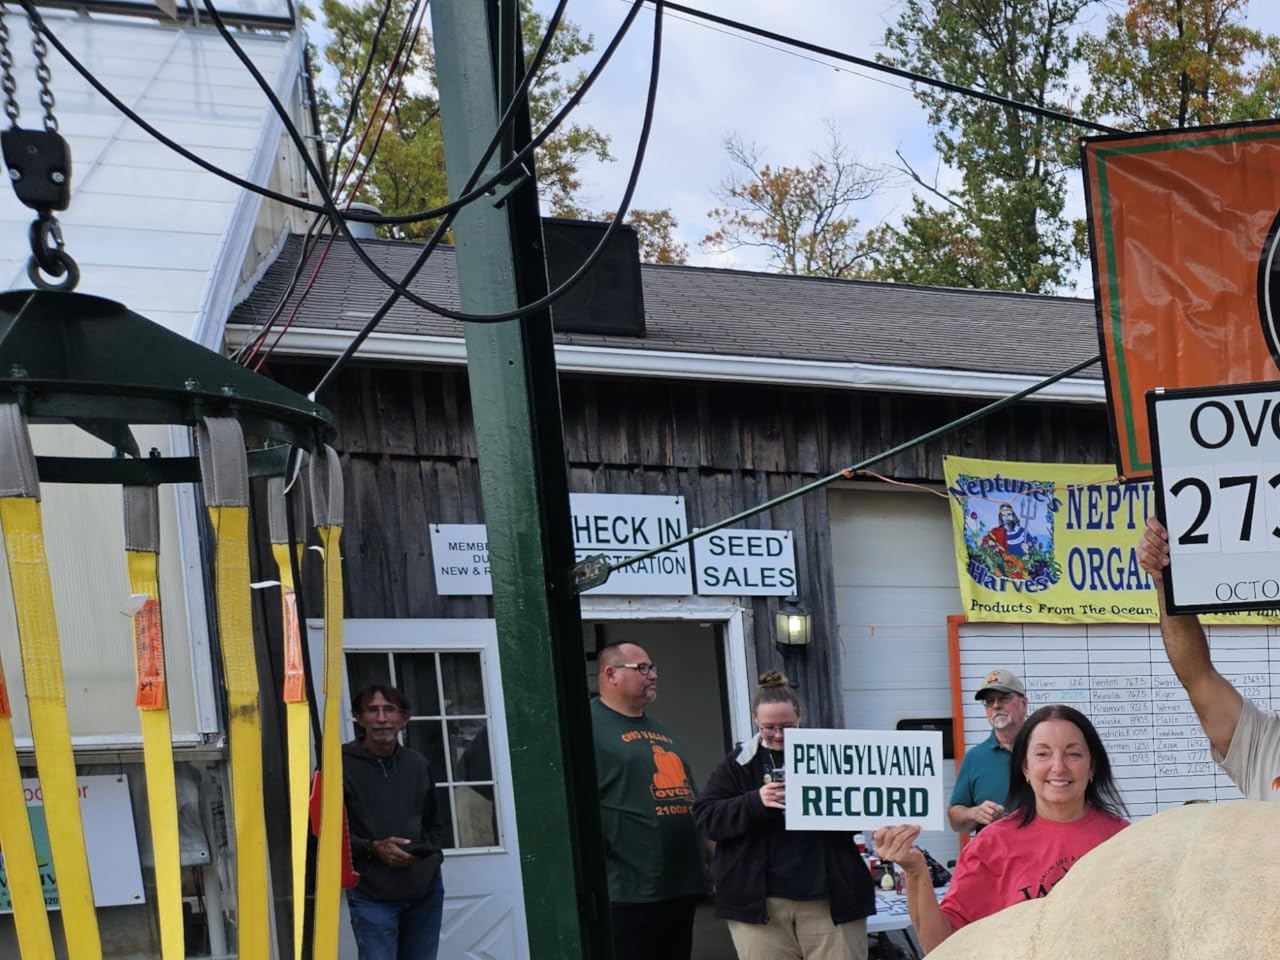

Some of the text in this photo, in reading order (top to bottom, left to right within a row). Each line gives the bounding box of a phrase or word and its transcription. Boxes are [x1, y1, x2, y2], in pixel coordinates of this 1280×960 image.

[572, 514, 682, 545] HECK IN
[709, 535, 783, 557] SEED
[441, 566, 469, 576] NEW
[472, 566, 480, 576] &
[703, 566, 796, 588] SALES
[968, 558, 1060, 593] Harvest
[970, 599, 1032, 614] Products
[1038, 603, 1075, 615] From
[1079, 604, 1105, 616] The
[793, 744, 935, 776] PENNSYLVANIA
[802, 785, 929, 817] RECORD
